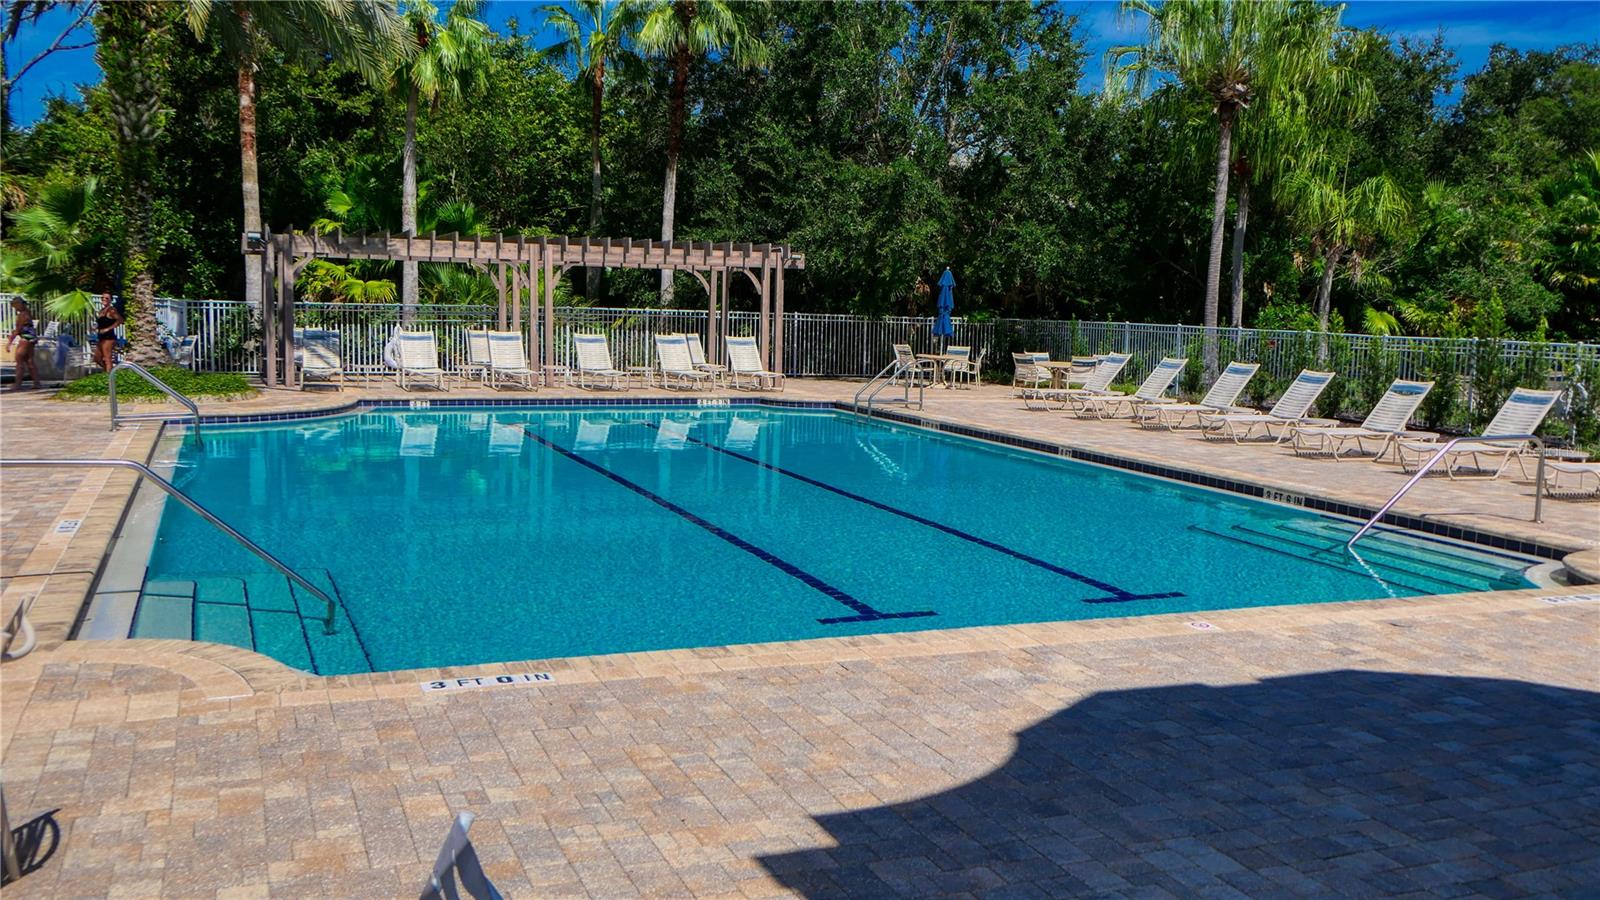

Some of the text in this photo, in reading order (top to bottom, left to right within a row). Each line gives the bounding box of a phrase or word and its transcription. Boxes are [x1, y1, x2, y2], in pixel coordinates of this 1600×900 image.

[1266, 490, 1303, 505] 3 FT 6 IN
[429, 673, 550, 689] 3 FT 0 IN
